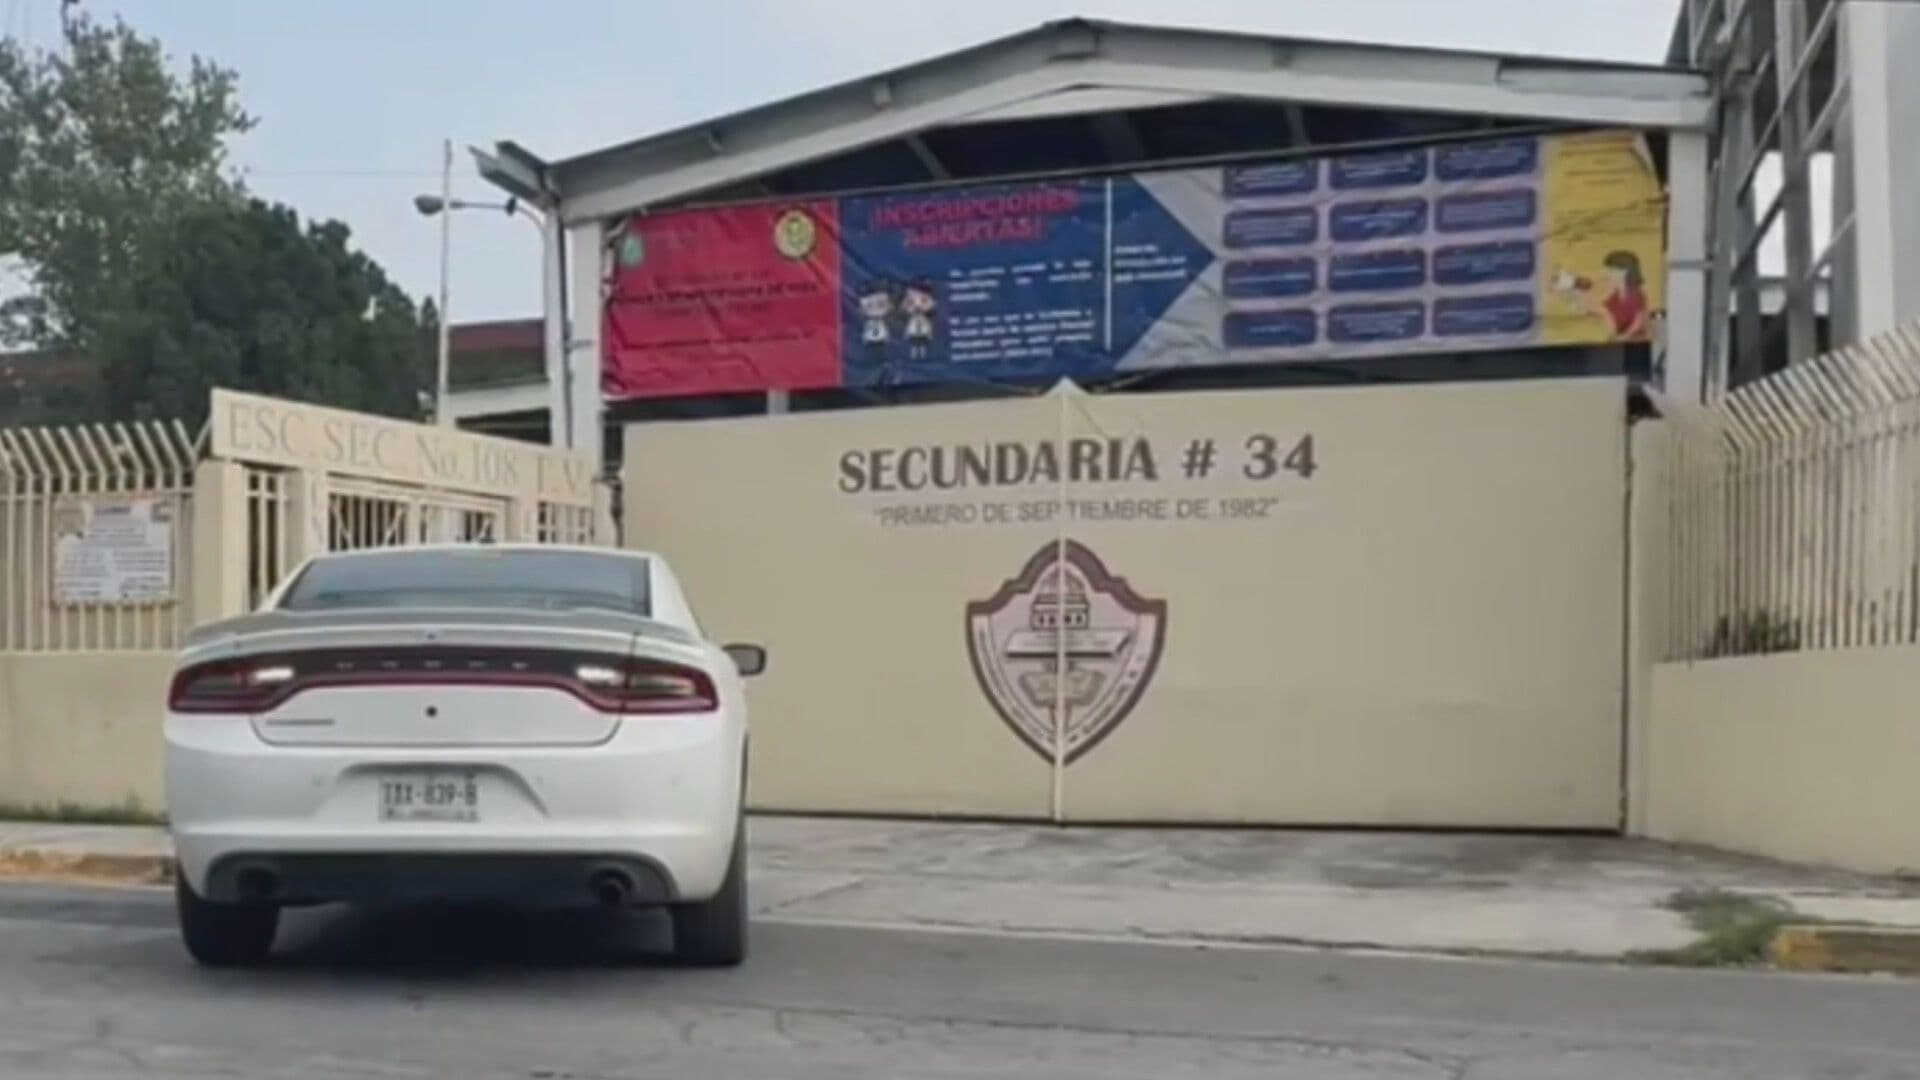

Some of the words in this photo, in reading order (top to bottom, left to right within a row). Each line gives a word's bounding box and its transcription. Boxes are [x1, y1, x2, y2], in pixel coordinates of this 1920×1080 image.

[472, 442, 518, 483] 108
[839, 437, 1158, 494] SECUNDARIA
[1182, 439, 1216, 478] #
[1243, 434, 1317, 479] 34
[983, 503, 1010, 523] DE
[1177, 499, 1208, 519] DE
